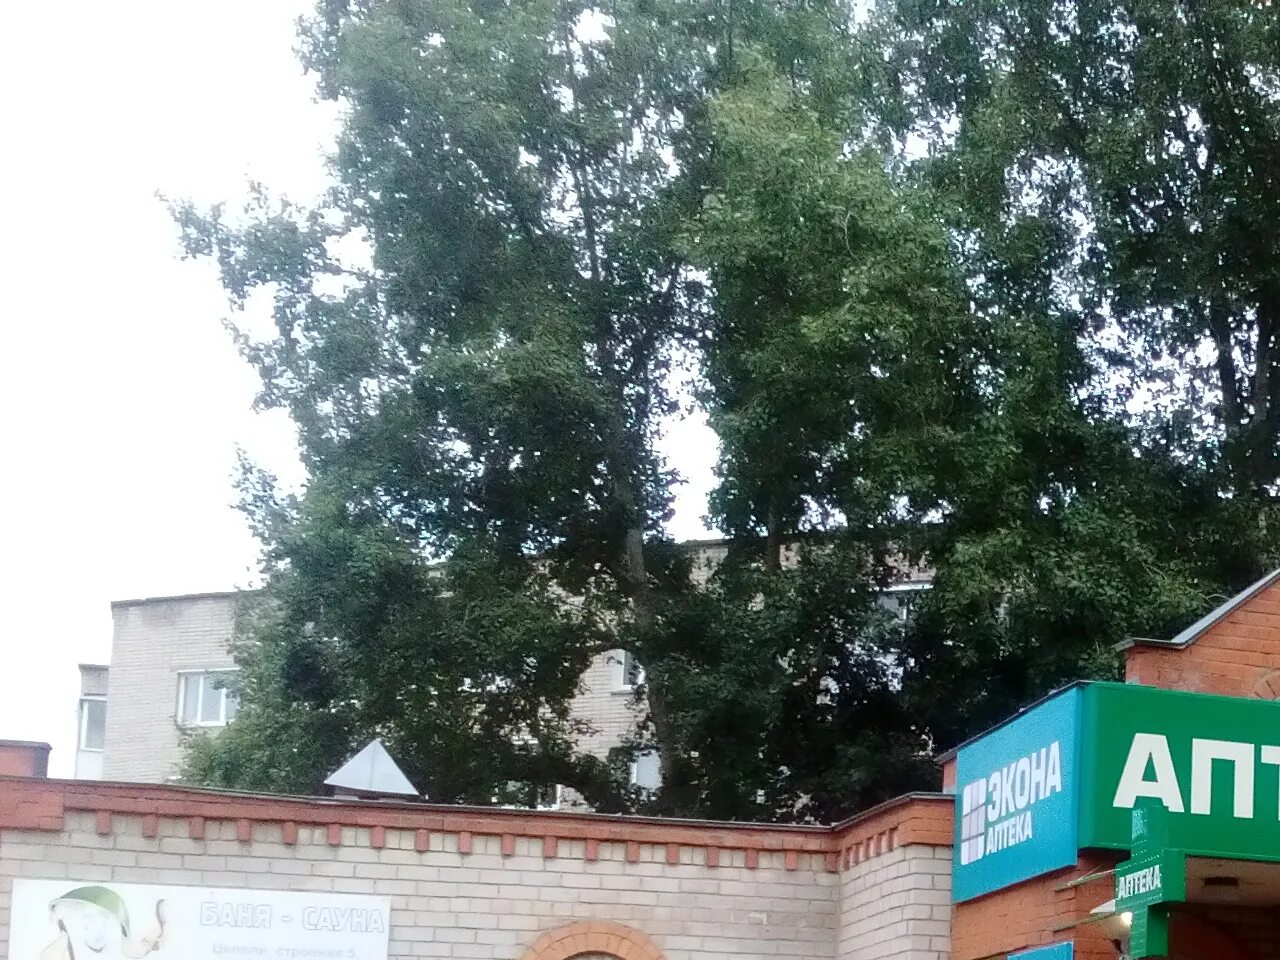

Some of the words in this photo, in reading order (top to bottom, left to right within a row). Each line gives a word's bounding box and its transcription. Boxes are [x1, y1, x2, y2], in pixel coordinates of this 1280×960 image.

[987, 741, 1062, 822] ЭКОНА
[985, 811, 1033, 856] АПТЕКА
[1118, 863, 1162, 899] АПТЕКА
[199, 902, 272, 928] БАНЯ
[301, 906, 384, 933] САУНА
